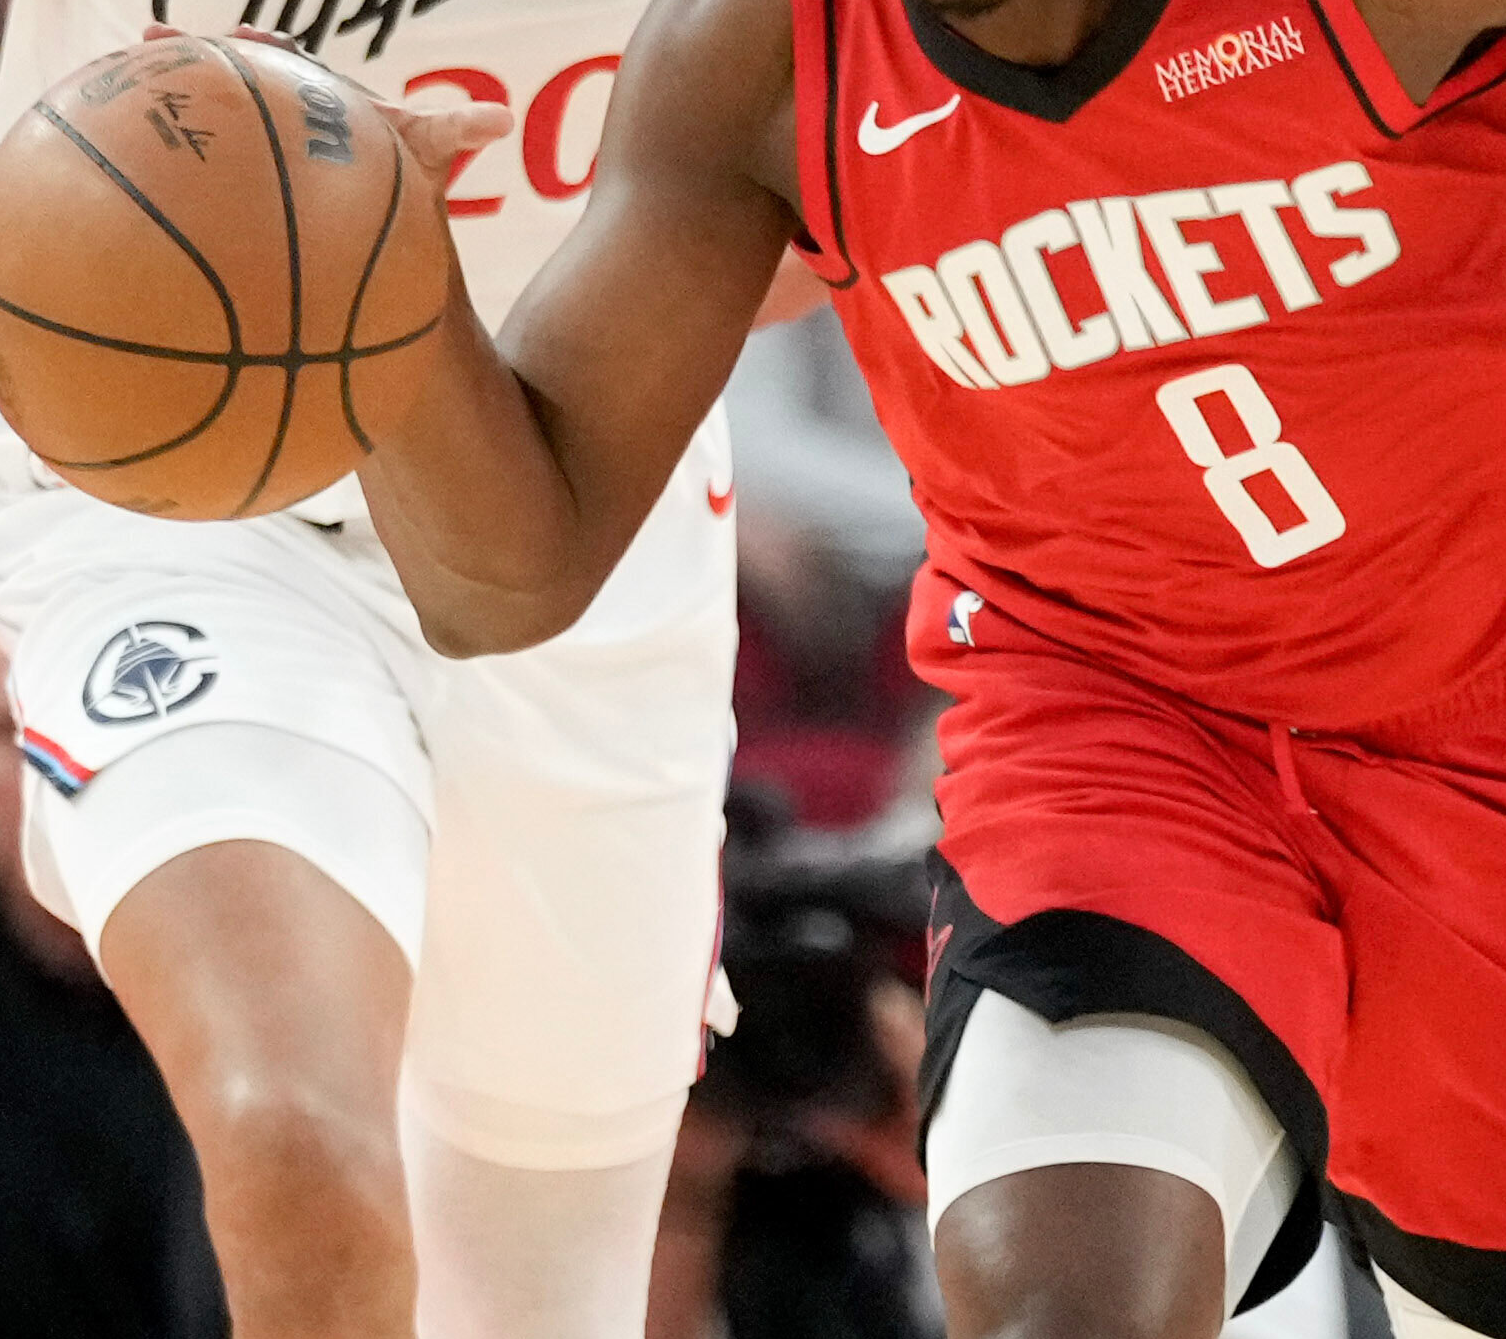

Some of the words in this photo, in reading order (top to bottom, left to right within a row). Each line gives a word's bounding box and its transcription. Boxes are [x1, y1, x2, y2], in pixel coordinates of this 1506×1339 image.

[1154, 16, 1300, 83] MEMORIAL
[1158, 29, 1305, 102] HERMANN
[405, 54, 624, 218] 20
[880, 161, 1401, 390] ROCKETS
[1155, 363, 1346, 569] 8
